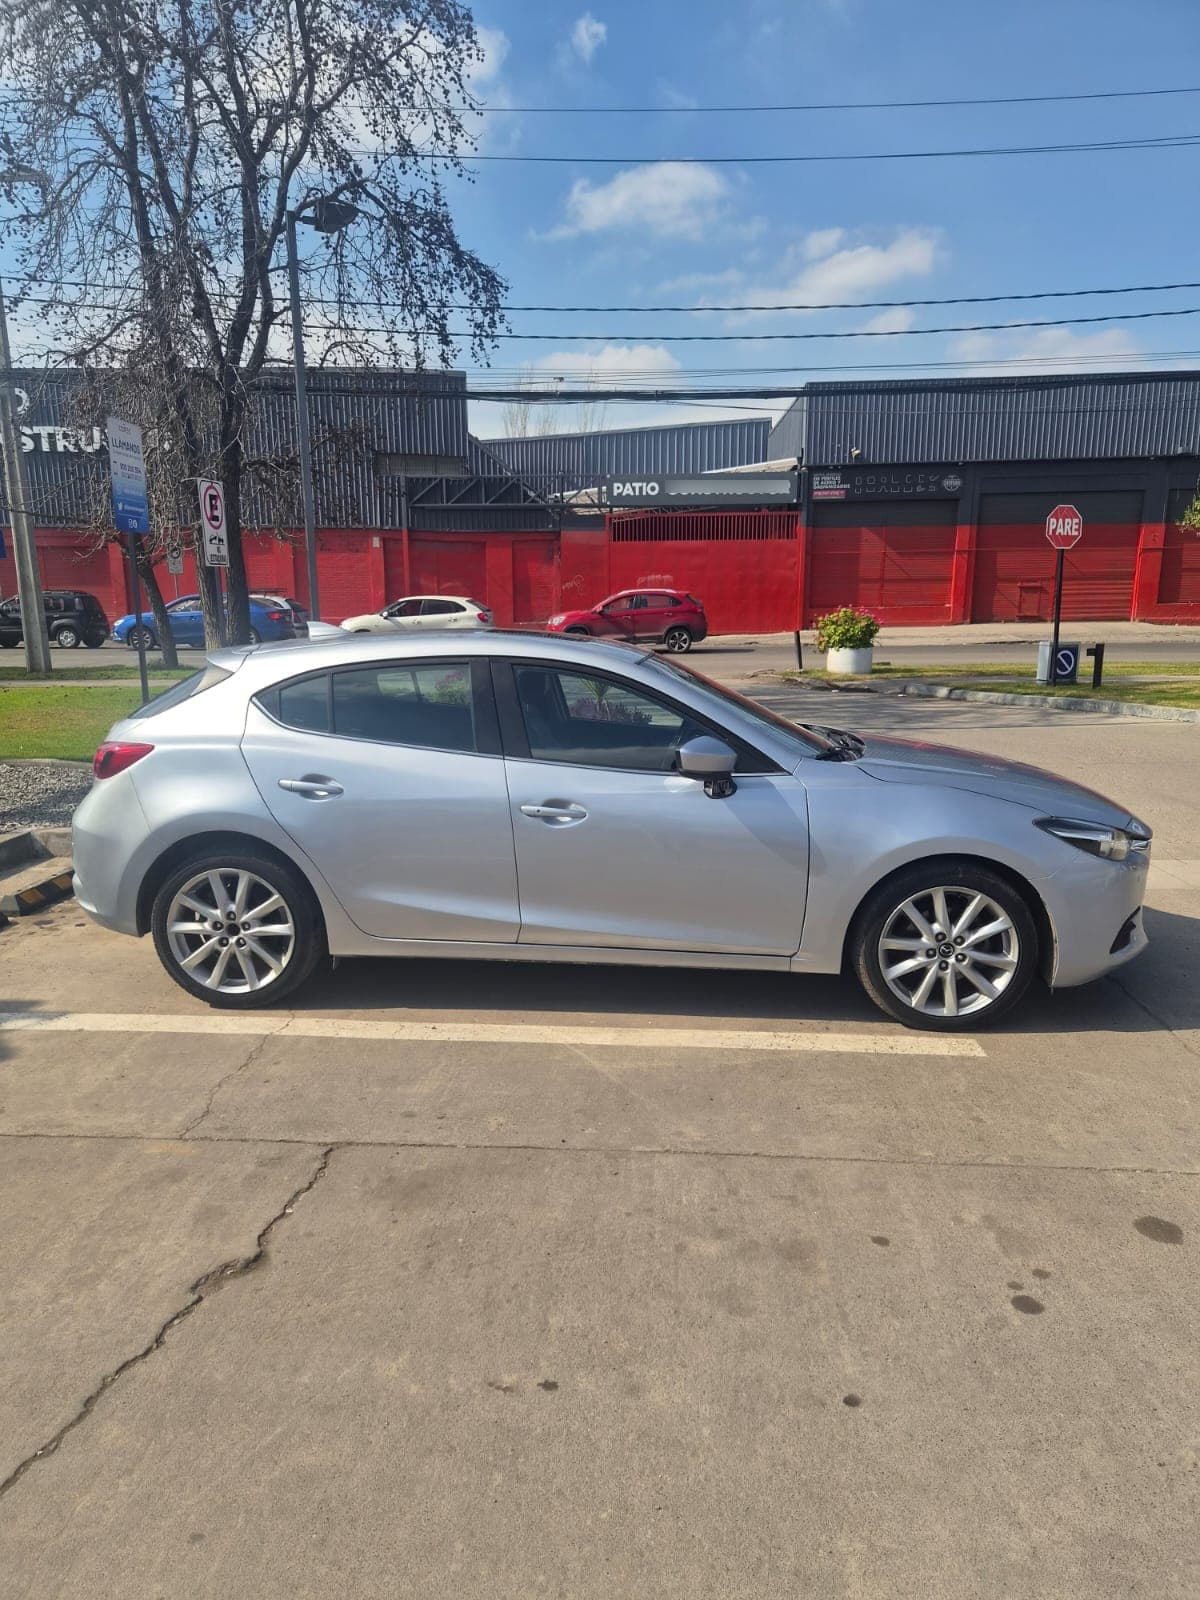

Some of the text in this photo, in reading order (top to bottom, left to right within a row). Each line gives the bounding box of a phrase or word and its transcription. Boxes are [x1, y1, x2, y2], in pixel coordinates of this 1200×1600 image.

[613, 482, 659, 497] PATIO
[208, 493, 220, 522] E
[1048, 518, 1080, 536] PARE
